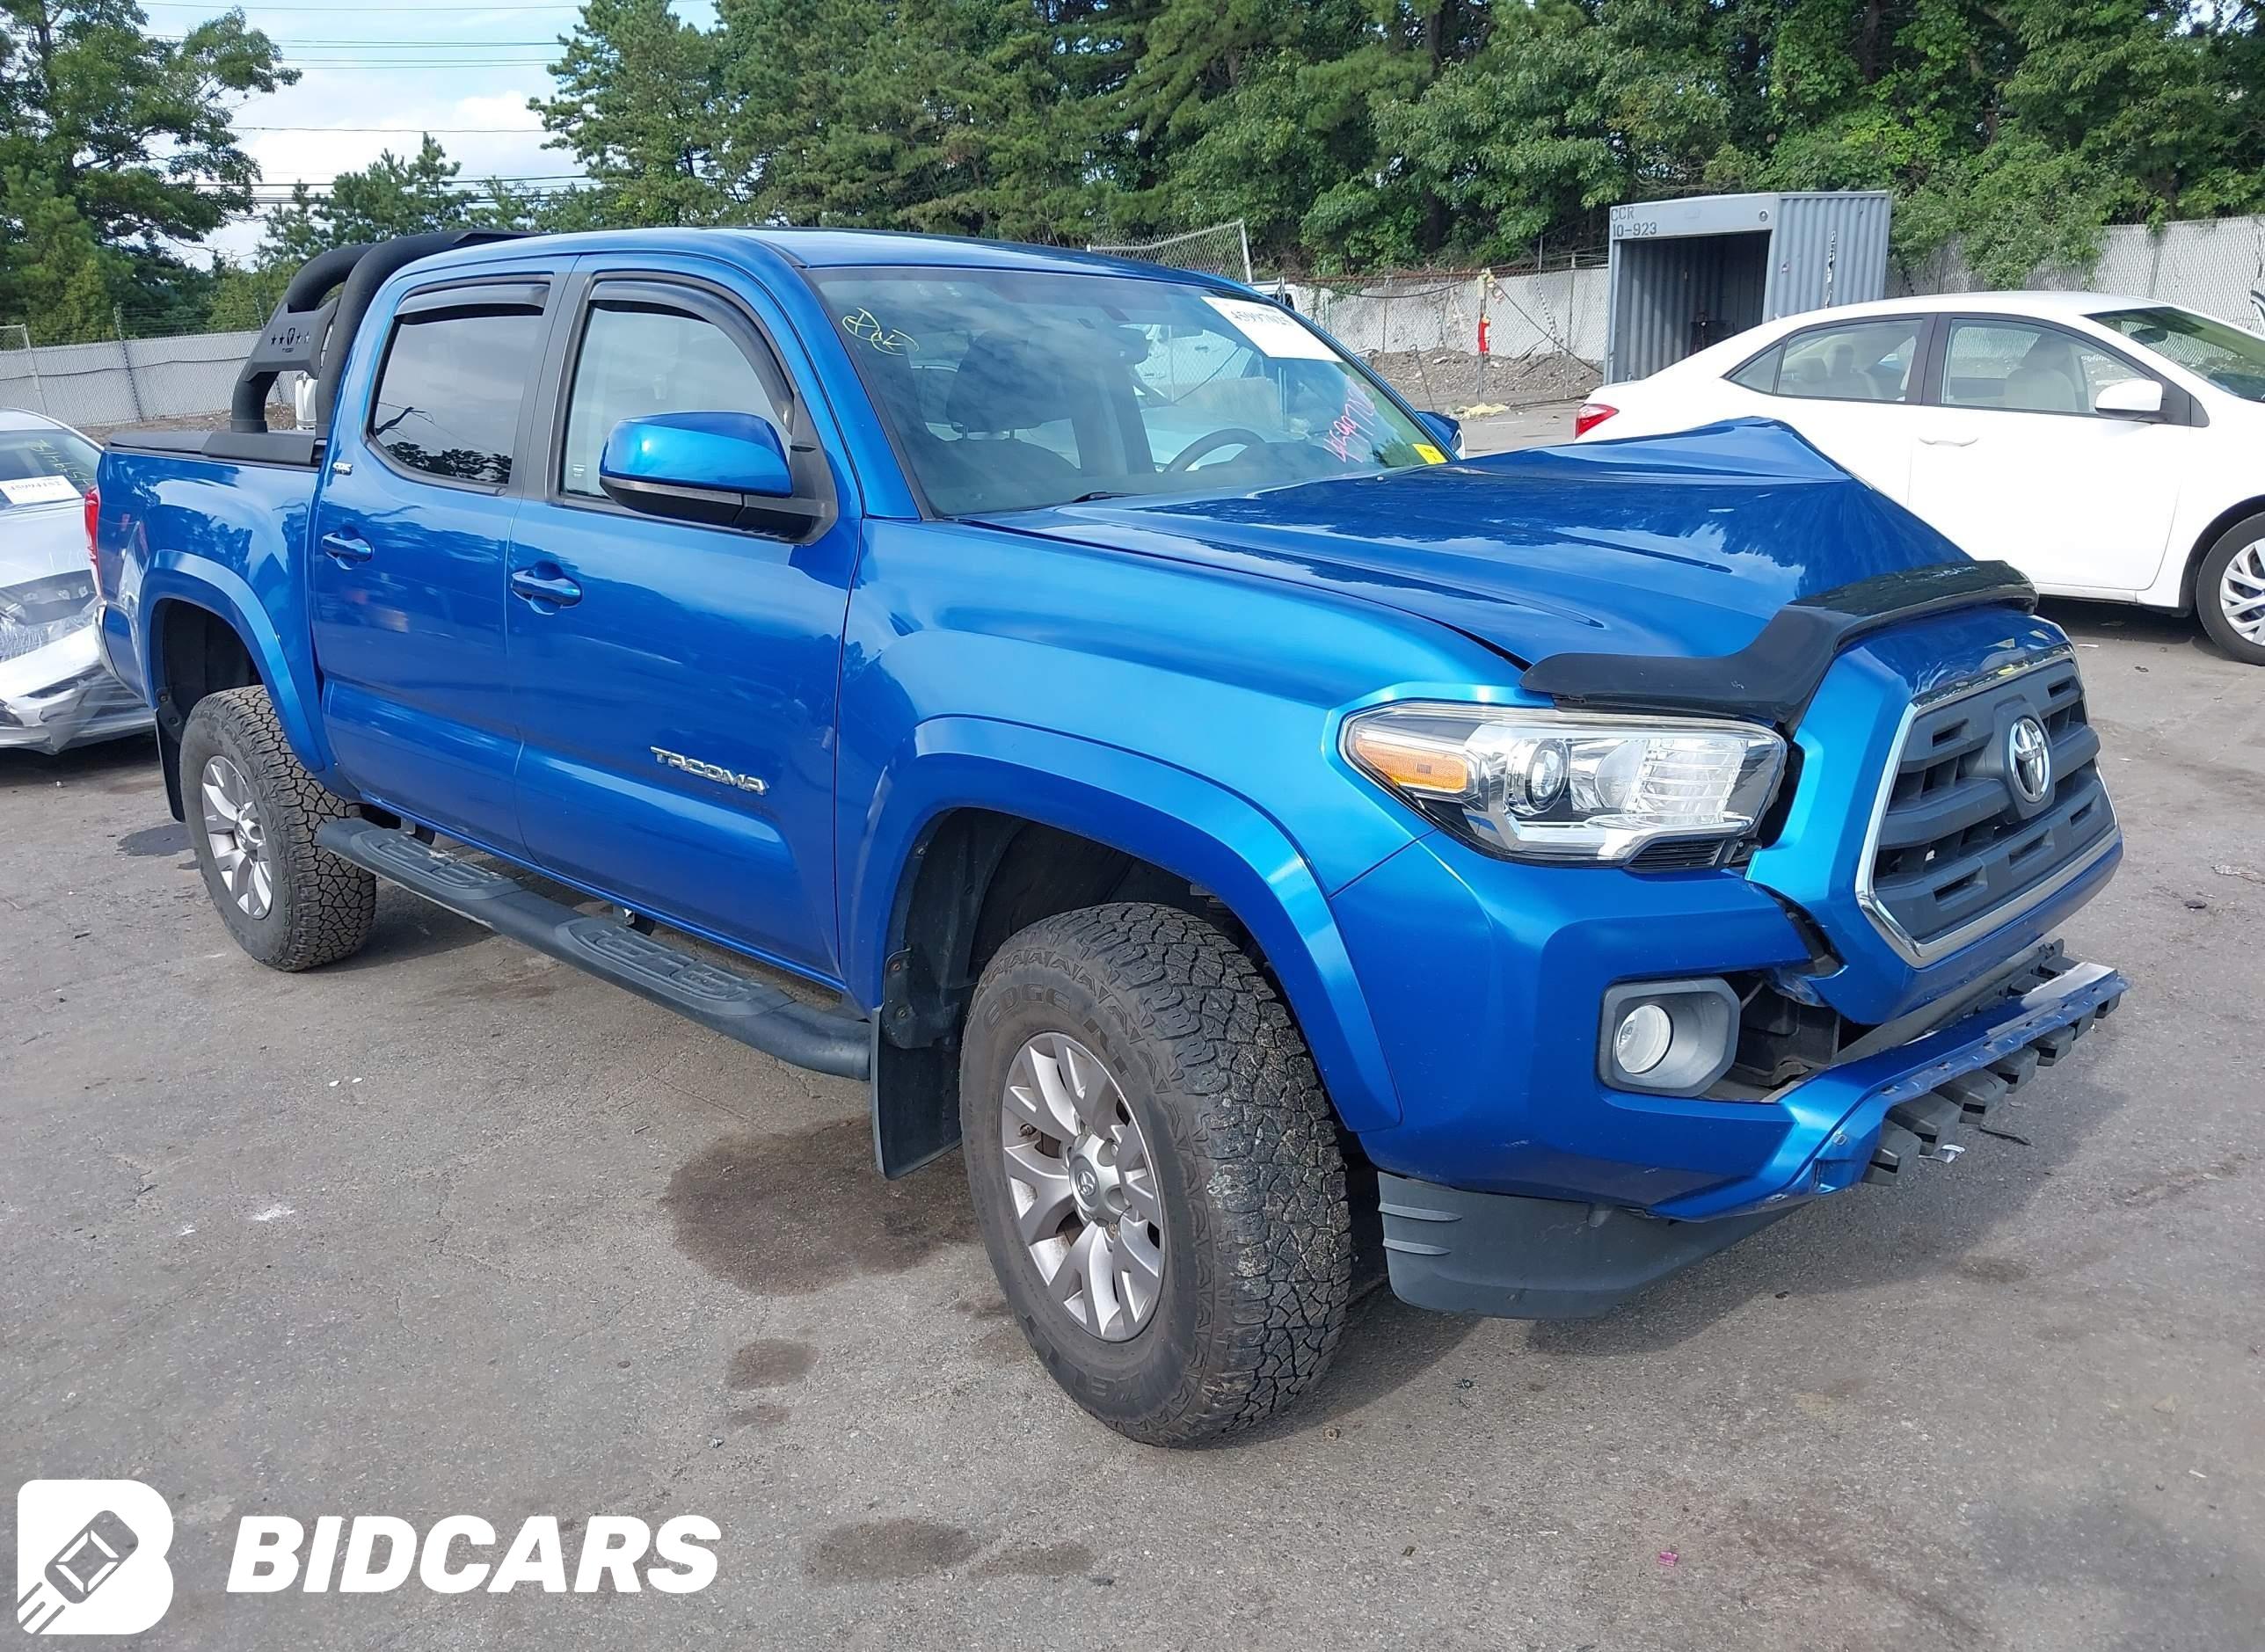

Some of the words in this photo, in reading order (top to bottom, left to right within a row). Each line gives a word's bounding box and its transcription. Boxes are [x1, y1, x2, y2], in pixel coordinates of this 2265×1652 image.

[1611, 206, 1635, 222] CCR
[1613, 222, 1657, 237] 10-923
[650, 746, 770, 797] TACOMA
